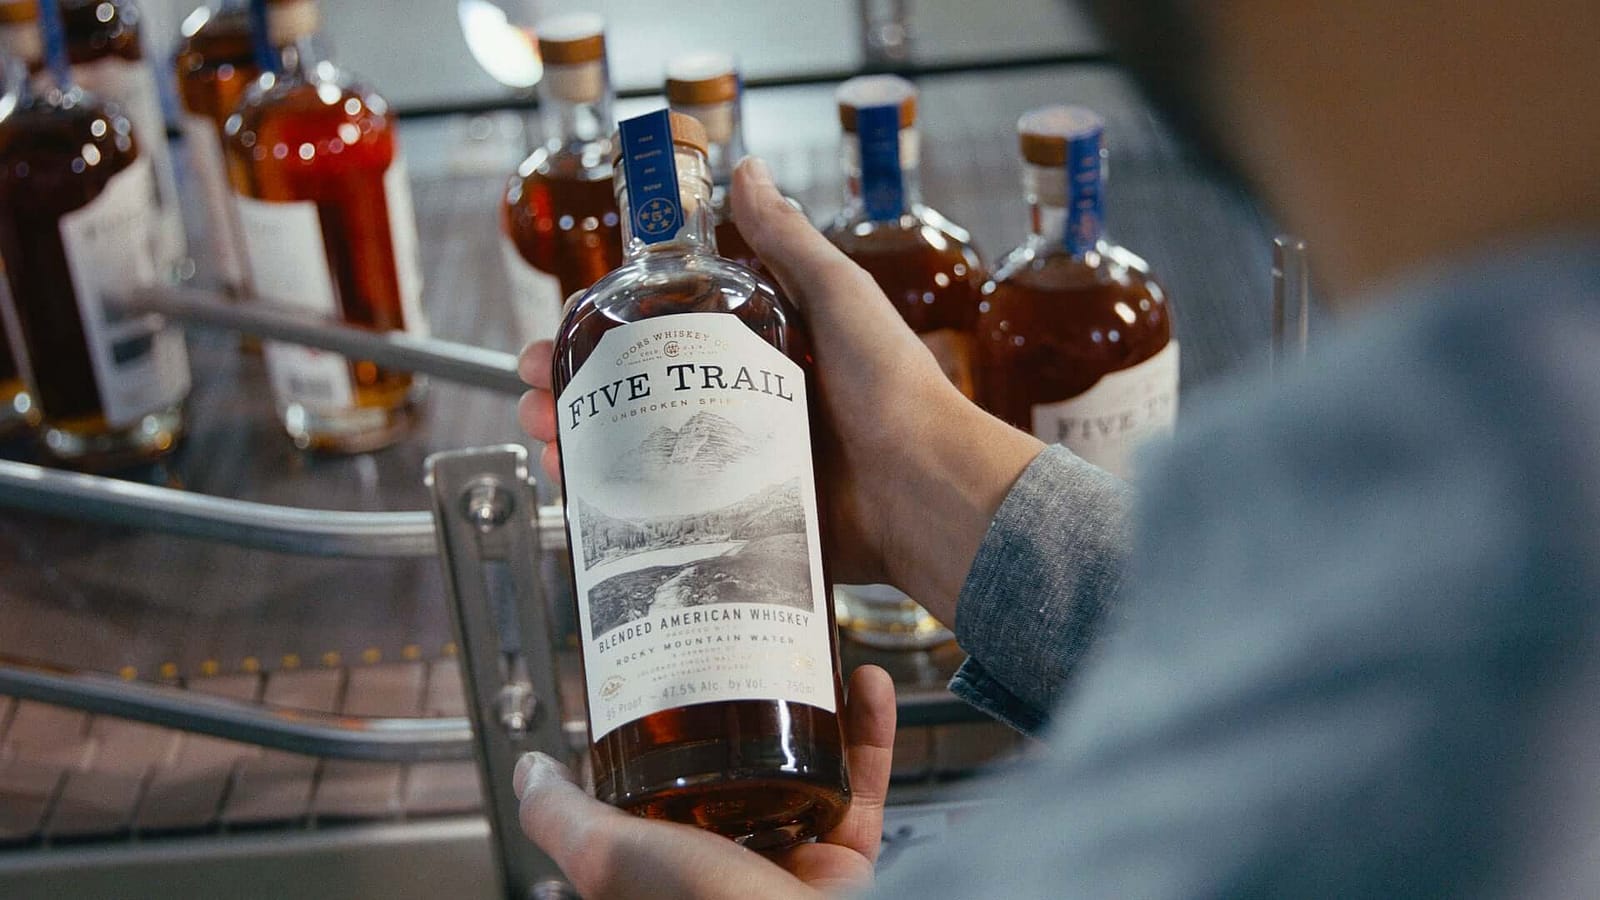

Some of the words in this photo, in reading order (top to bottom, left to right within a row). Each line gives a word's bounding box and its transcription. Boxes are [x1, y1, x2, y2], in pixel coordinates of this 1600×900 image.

[616, 337, 650, 367] COORS
[652, 329, 711, 342] WHISKEY
[567, 372, 651, 430] FIVE
[666, 363, 794, 402] TRAIL
[611, 399, 689, 423] UNBROKEN
[598, 622, 653, 654] BLENDED
[660, 608, 742, 630] AMERICAN
[749, 608, 810, 627] WHISKEY
[616, 647, 656, 667] ROCKY
[664, 634, 742, 651] MOUNTAIN
[749, 634, 795, 645] WATER
[729, 677, 741, 692] by
